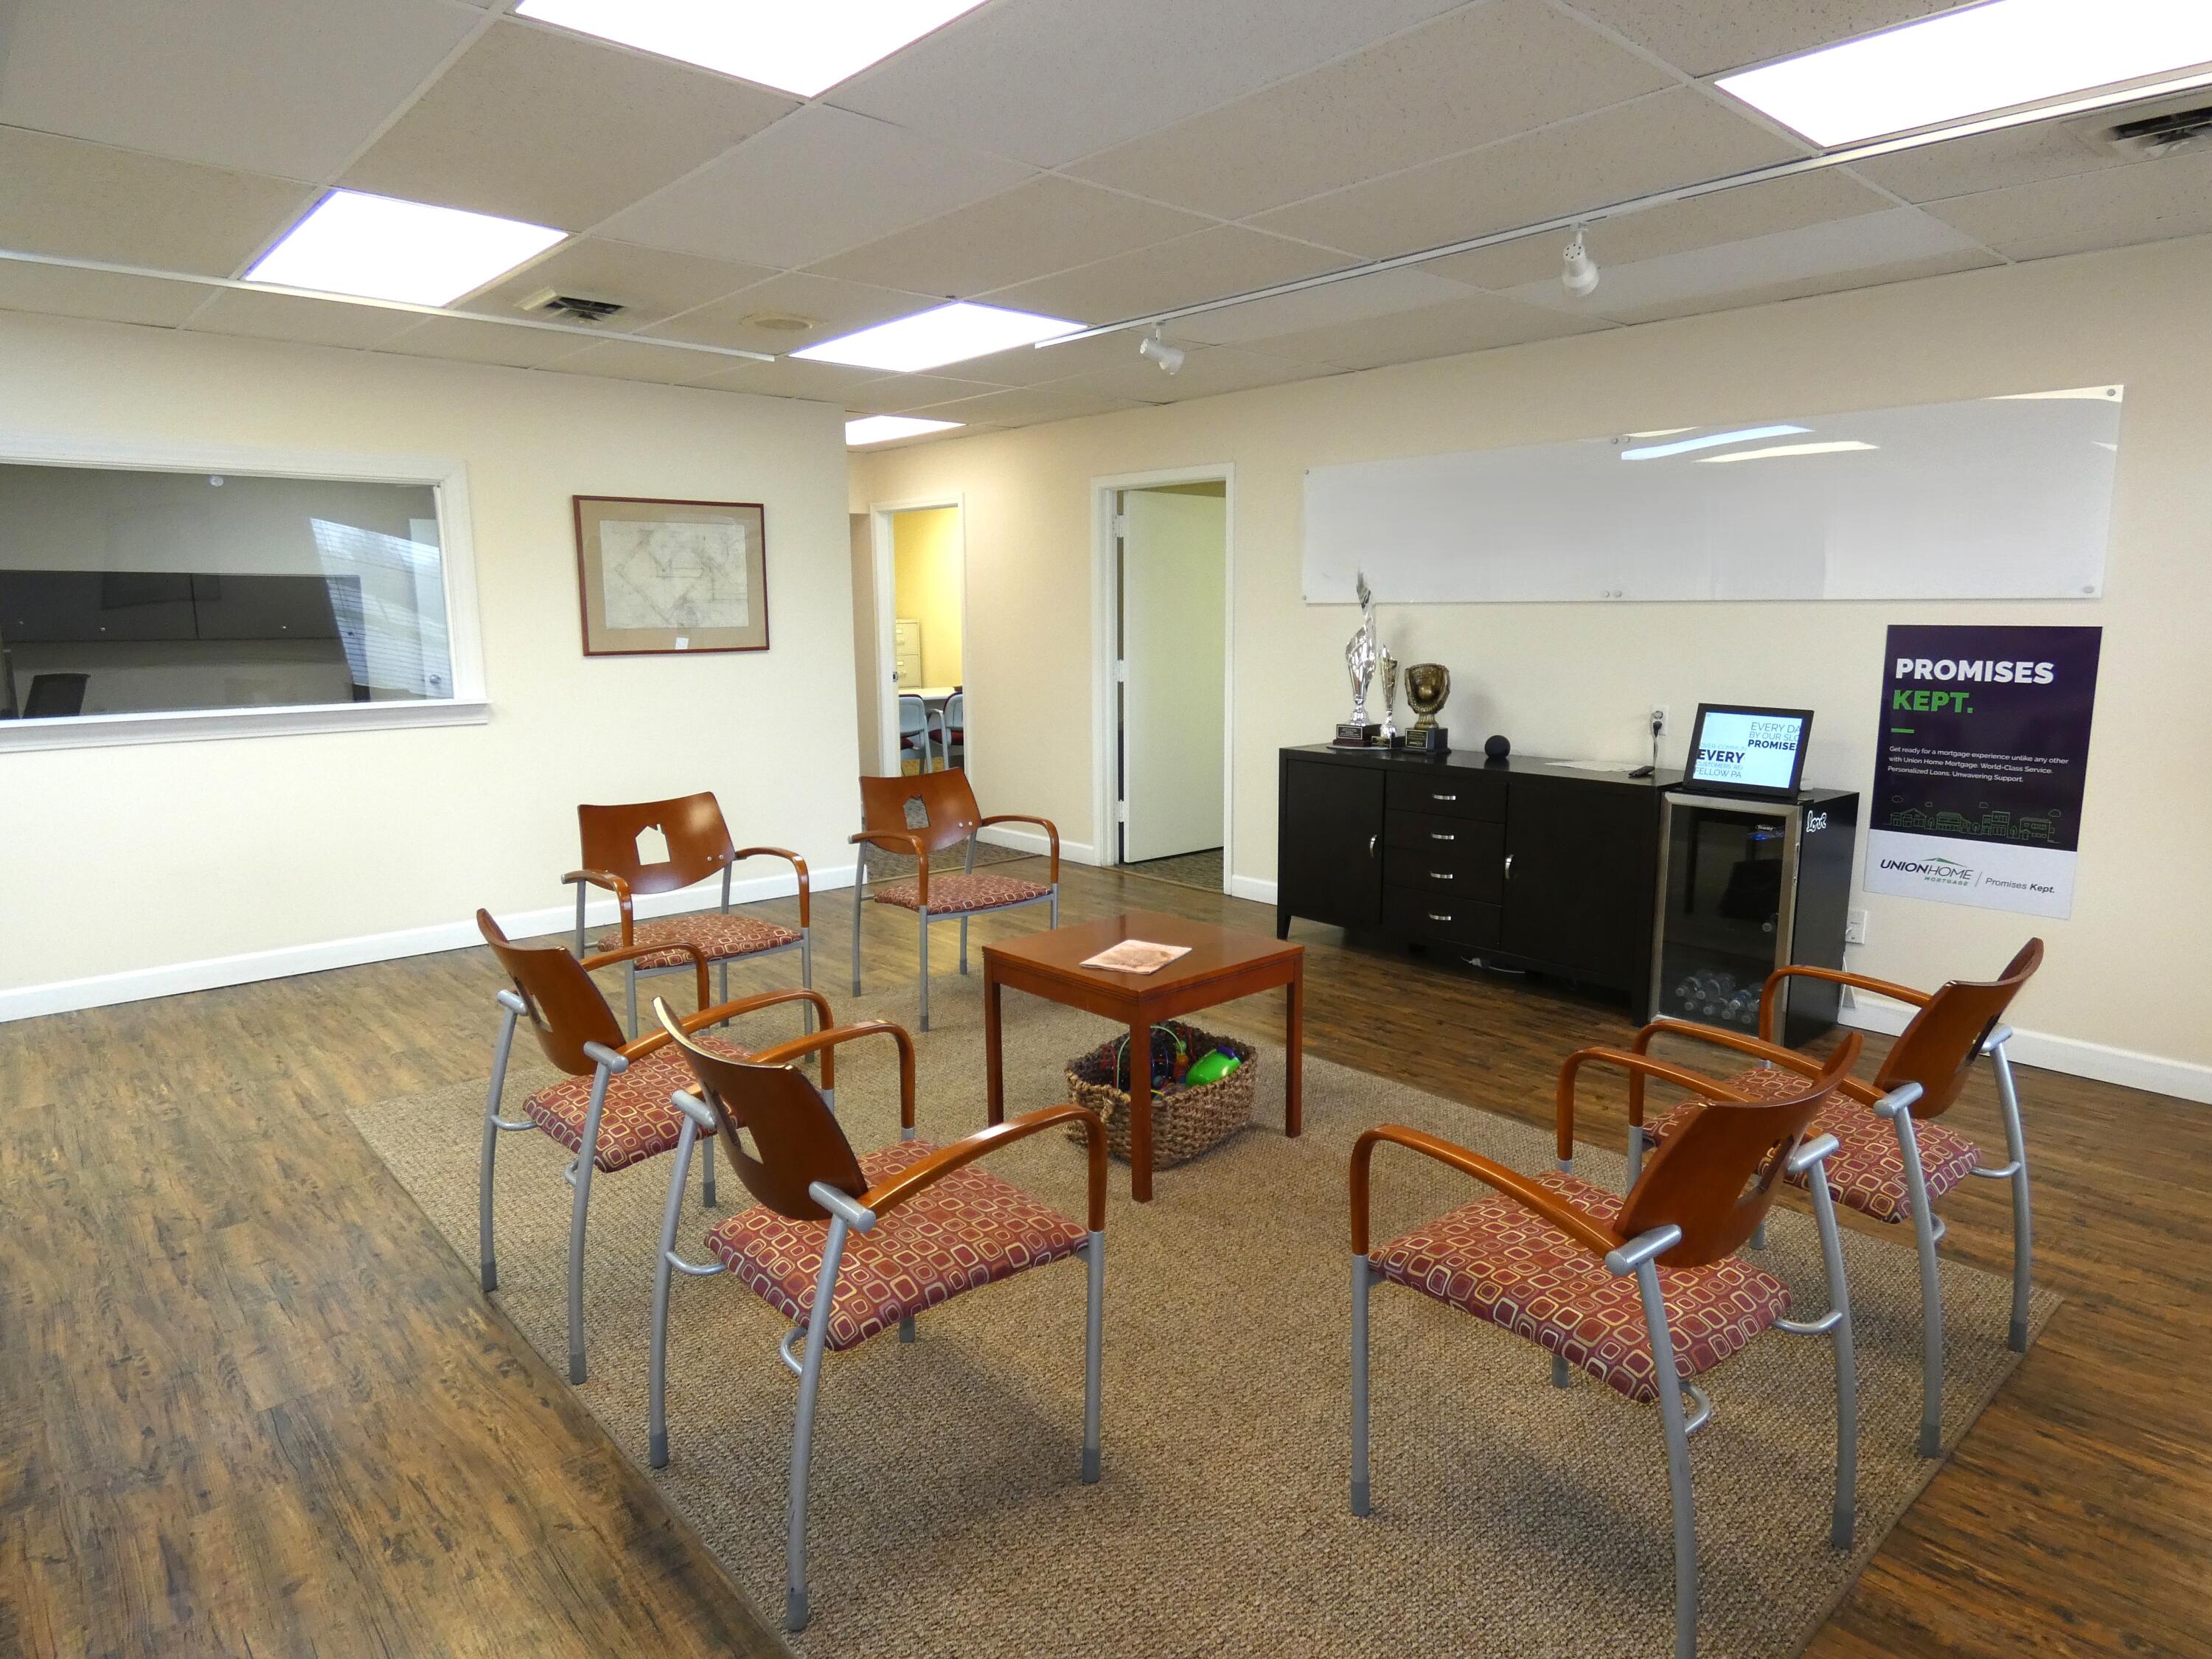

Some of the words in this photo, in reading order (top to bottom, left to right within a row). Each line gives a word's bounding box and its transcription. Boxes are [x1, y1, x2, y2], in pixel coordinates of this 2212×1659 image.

[1895, 658, 2054, 684] PROMISES
[1892, 689, 1974, 714] KEPT.
[1751, 722, 1785, 732] EVERY
[1762, 732, 1781, 740] OUR
[1747, 740, 1798, 751] PROMISE
[1697, 749, 1745, 763] EVERY
[1937, 749, 1971, 758] mortgage
[1695, 768, 1729, 777] FELLOW
[1980, 762, 2023, 772] World-Class
[2024, 766, 2053, 774] Service.
[1888, 766, 1929, 775] Personalized
[1952, 771, 1992, 781] Unwavering
[1993, 774, 2023, 782] Support.
[1924, 877, 1969, 886] MORTGAGE
[1985, 877, 2028, 890] Promises
[2029, 883, 2055, 894] Kept.
